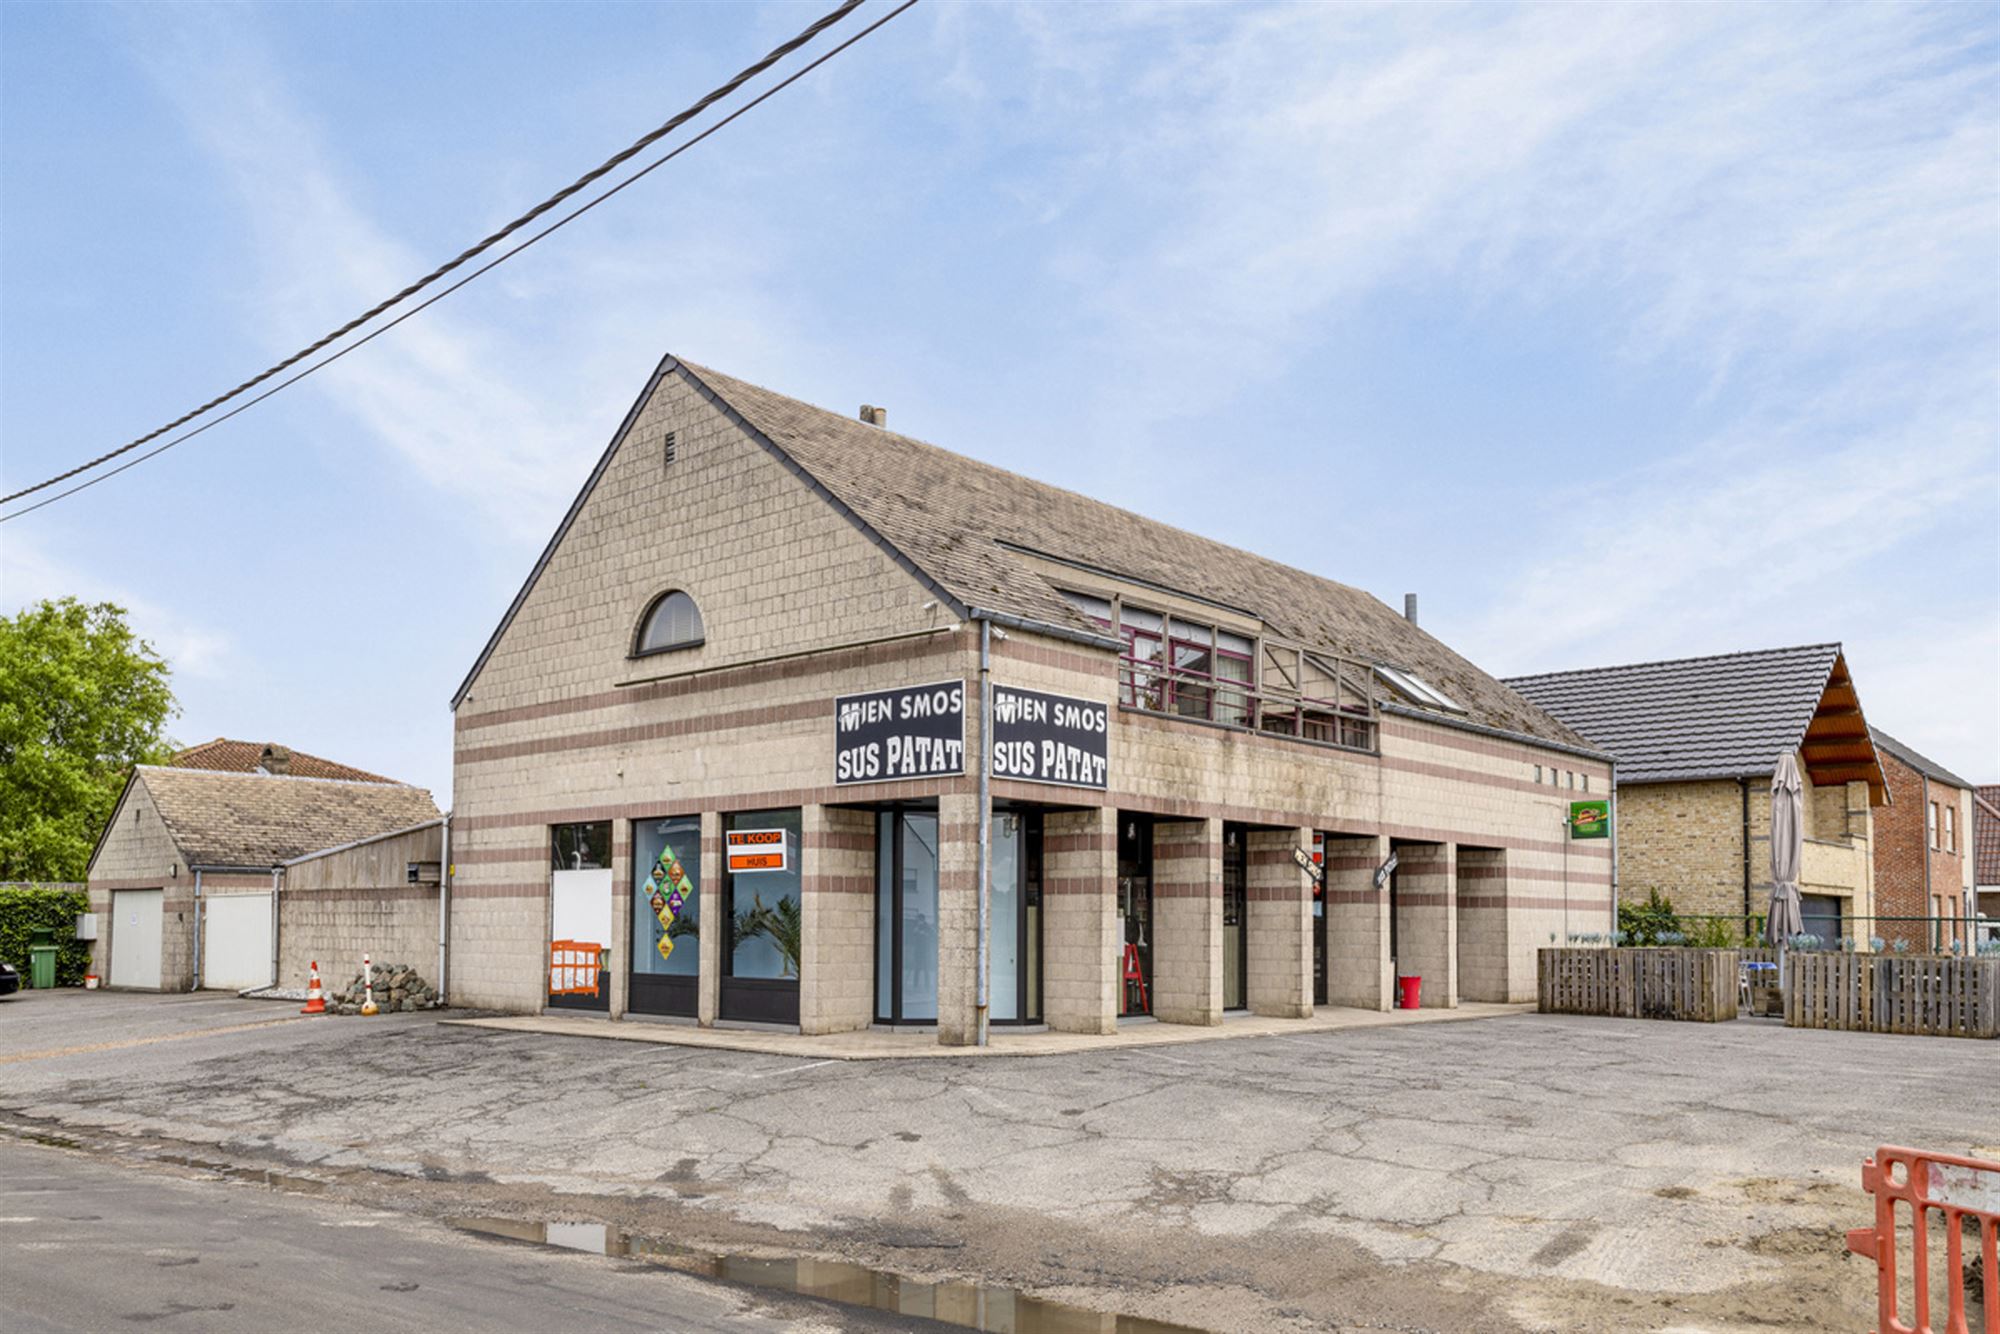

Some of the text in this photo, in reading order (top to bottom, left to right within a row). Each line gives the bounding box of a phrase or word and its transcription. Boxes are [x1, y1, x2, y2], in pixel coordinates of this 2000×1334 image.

[840, 688, 962, 732] MIEN SMOS
[996, 692, 1106, 733] MIEN SMOS
[838, 735, 962, 780] SUS PATAT
[994, 739, 1106, 784] SUS PATAT
[731, 833, 780, 844] TE KOOP
[747, 857, 767, 866] HUIS
